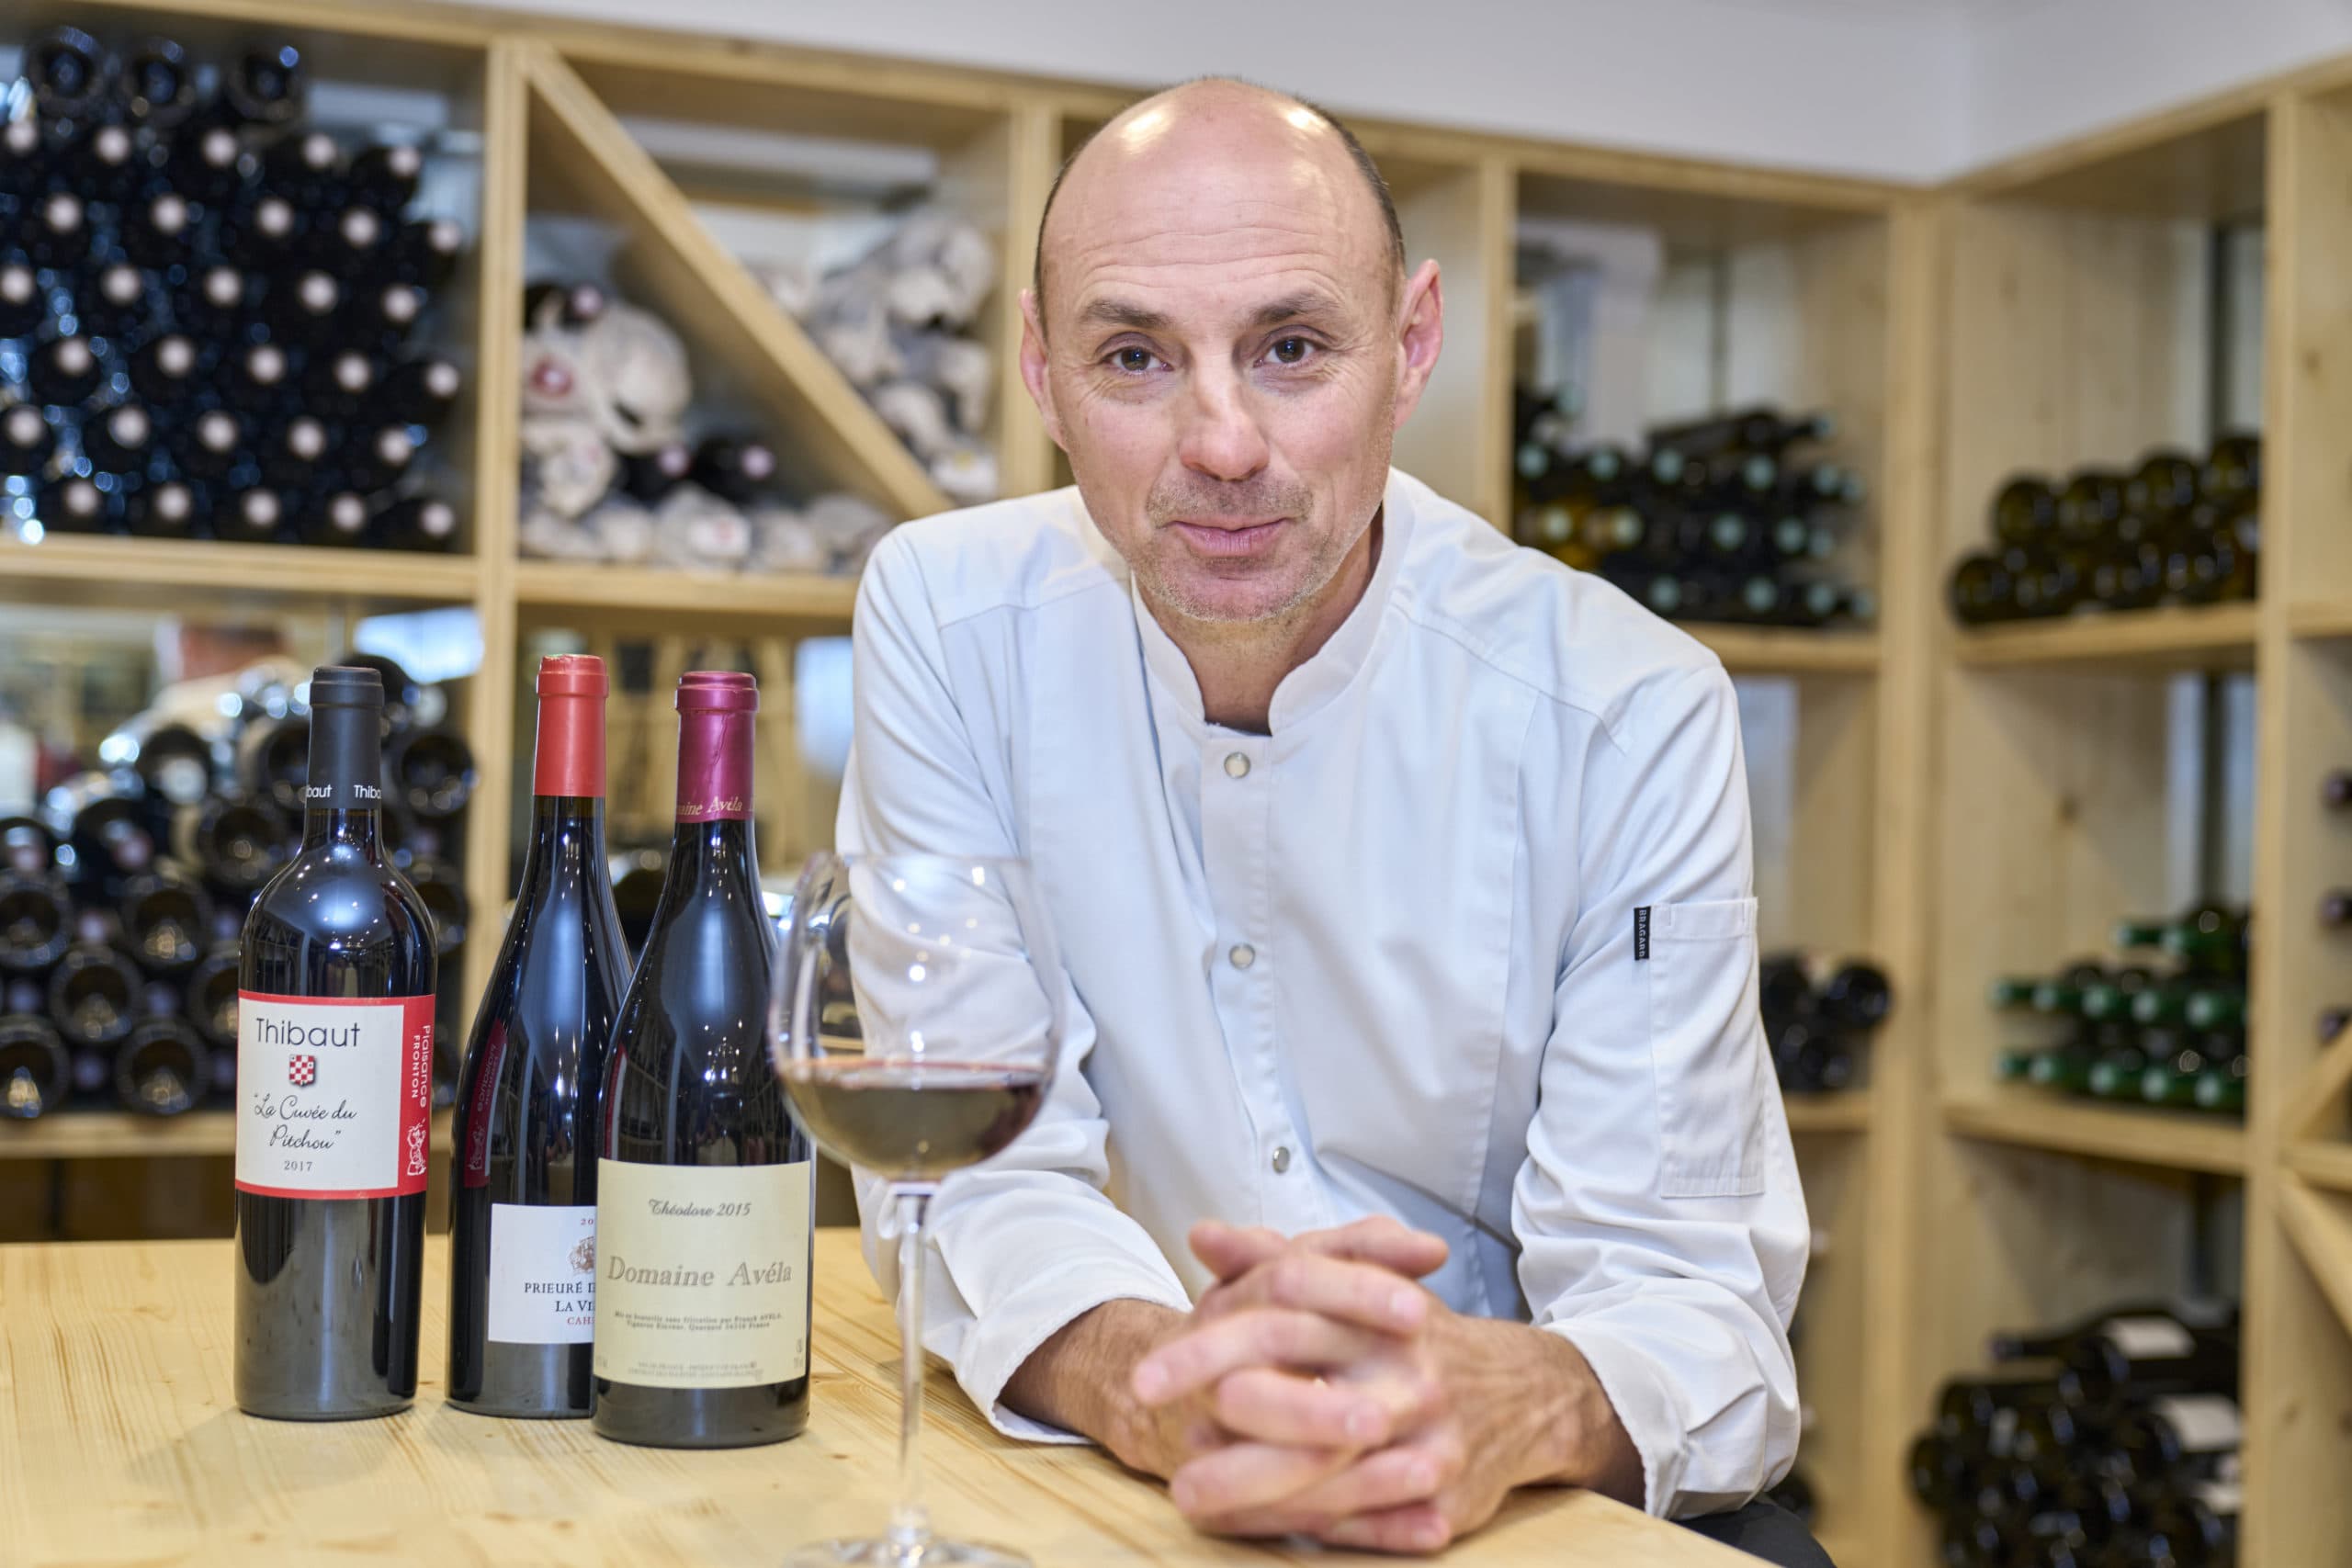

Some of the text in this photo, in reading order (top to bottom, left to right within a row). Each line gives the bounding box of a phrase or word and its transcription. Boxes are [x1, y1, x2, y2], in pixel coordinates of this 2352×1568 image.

[1639, 909, 1647, 957] BRAGARD
[256, 1017, 361, 1047] Thibaut
[412, 1034, 421, 1099] FRONTON
[420, 1025, 432, 1109] Plaisance
[279, 1094, 329, 1120] Cuvée
[331, 1100, 357, 1120] du
[283, 1160, 313, 1172] 2017
[649, 1198, 752, 1217] Théodore 2015
[607, 1255, 793, 1287] Domaine Avéla
[524, 1281, 583, 1294] PRIEURÉ
[555, 1300, 574, 1312] LA
